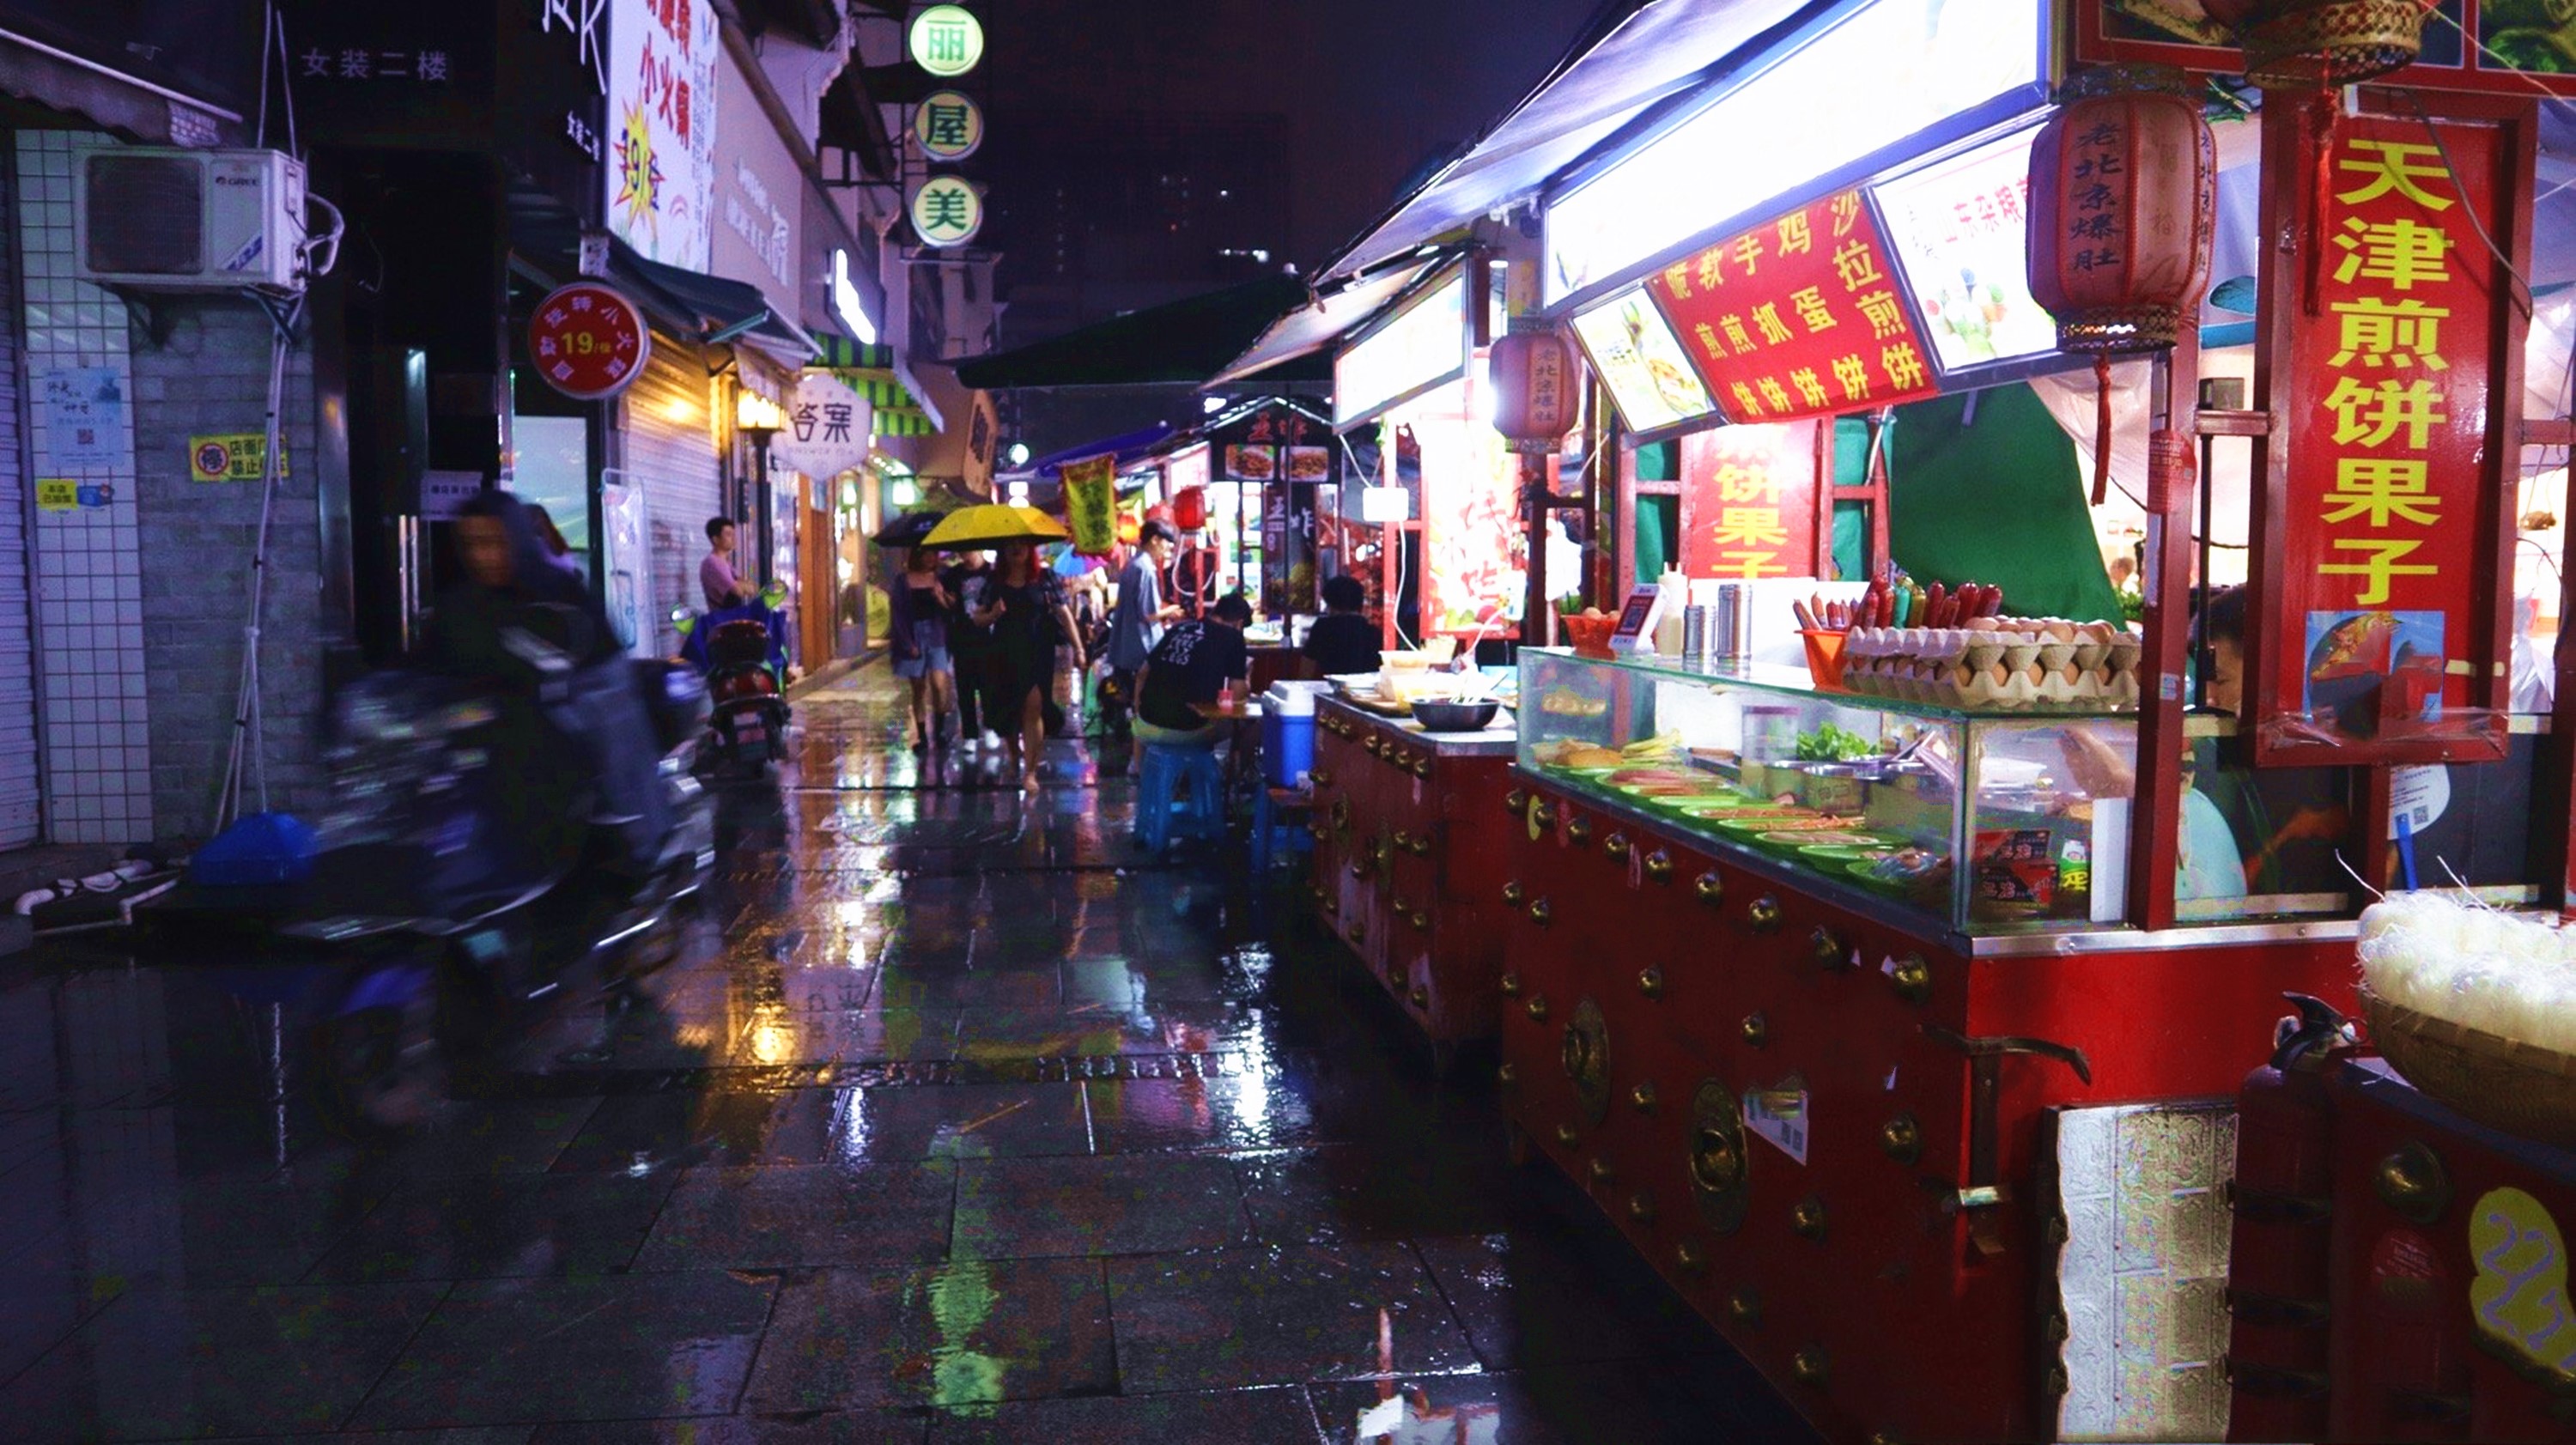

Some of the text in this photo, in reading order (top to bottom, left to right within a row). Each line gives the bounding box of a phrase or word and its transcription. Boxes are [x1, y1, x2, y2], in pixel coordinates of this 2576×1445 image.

[301, 47, 446, 80] 女装二楼
[925, 19, 969, 230] 丽屋美
[1830, 190, 1925, 391] 沙拉煎饼
[2069, 123, 2124, 272] 老北京爆肚
[2318, 138, 2455, 605] 天津煎饼果子
